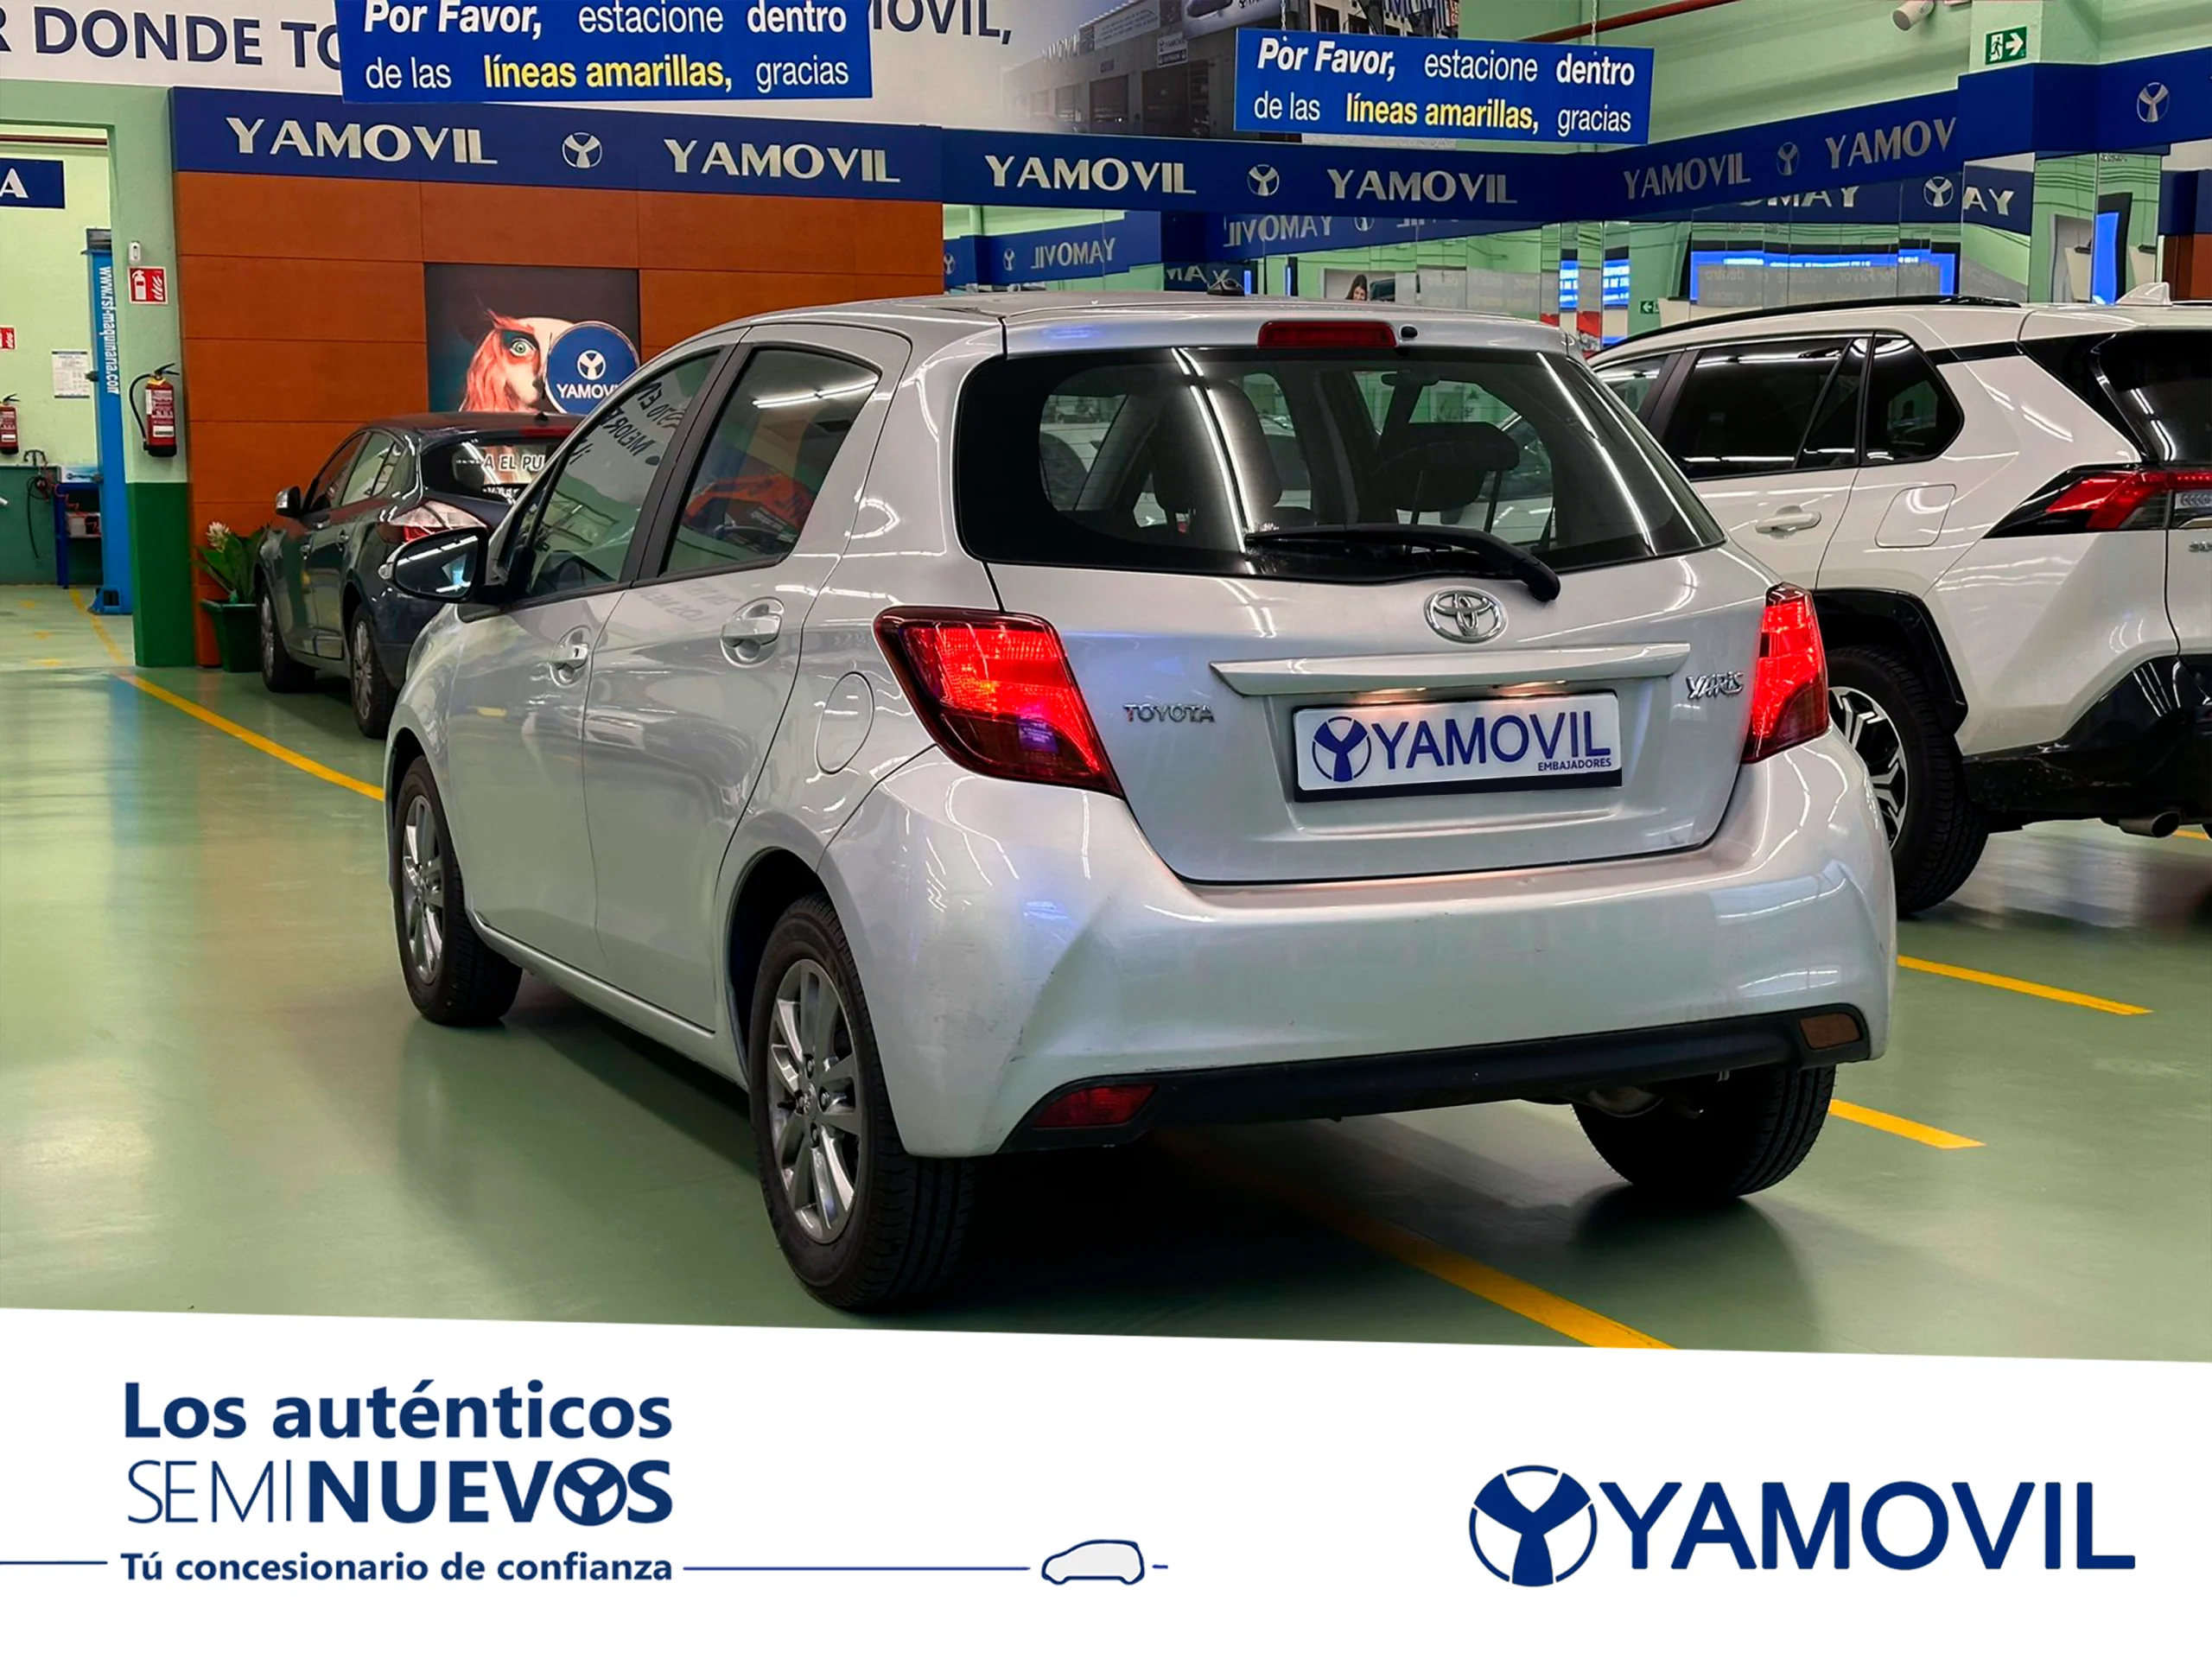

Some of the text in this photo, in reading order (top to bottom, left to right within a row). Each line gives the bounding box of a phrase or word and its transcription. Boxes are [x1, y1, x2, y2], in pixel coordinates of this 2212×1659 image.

[34, 6, 263, 66] DONDE
[364, 0, 848, 41] Por Favor, estacione dentro
[365, 54, 849, 94] de las líneas amarillas, gracias
[1257, 37, 1636, 86] Por Favor, estacione dentro
[1254, 90, 1632, 137] de las líneas amarillas, gracias
[226, 116, 499, 165] YAMOVIL
[663, 137, 901, 183] YAMOVIL
[984, 155, 1198, 194] YAMOVIL
[1326, 168, 1518, 205] YAMOVIL
[1623, 152, 1751, 200] YAMOVIL
[556, 383, 620, 398] YAMOV
[499, 454, 516, 471] EL
[1122, 702, 1216, 723] TOYOTA
[1371, 709, 1612, 770] YAMOVIL
[1538, 758, 1612, 772] EMBAJADORES
